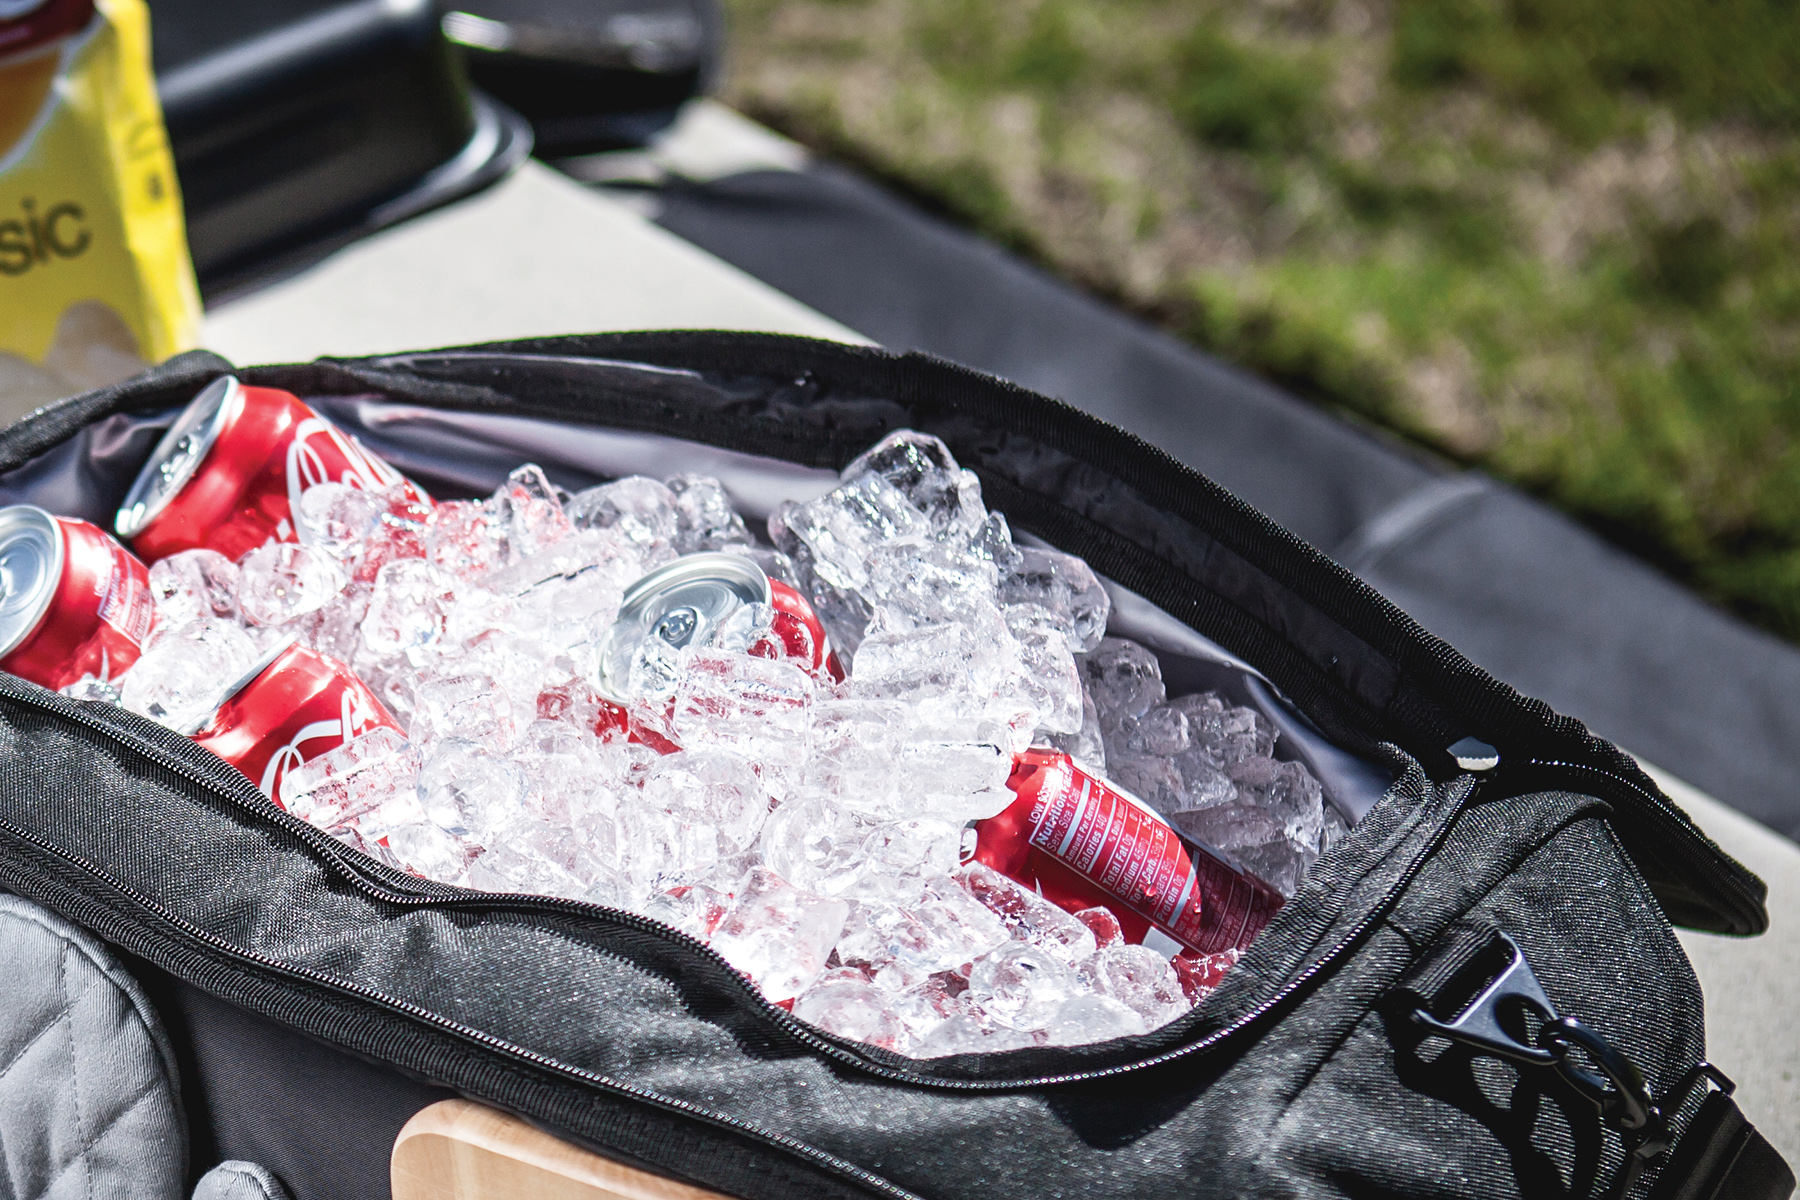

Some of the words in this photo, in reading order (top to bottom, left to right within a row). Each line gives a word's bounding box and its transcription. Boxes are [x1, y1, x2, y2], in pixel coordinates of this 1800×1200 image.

[1028, 802, 1045, 824] LOW
[1046, 827, 1065, 852] Serv.
[1058, 809, 1073, 829] Size
[1068, 787, 1081, 804] Can
[1065, 832, 1084, 862] Amount
[1078, 820, 1089, 834] Per
[1084, 797, 1099, 821] Serving
[1076, 829, 1101, 871] Calories
[1095, 814, 1107, 831] 140
[1121, 832, 1135, 847] 0g
[1114, 844, 1130, 863] Fat
[1116, 860, 1139, 896] Sodium
[1132, 837, 1149, 862] 45mg
[1161, 856, 1176, 875] 39g
[1102, 862, 1122, 887] Total
[1141, 855, 1158, 881] Carb.
[1155, 885, 1180, 922] Protein
[1172, 874, 1186, 888] 0g
